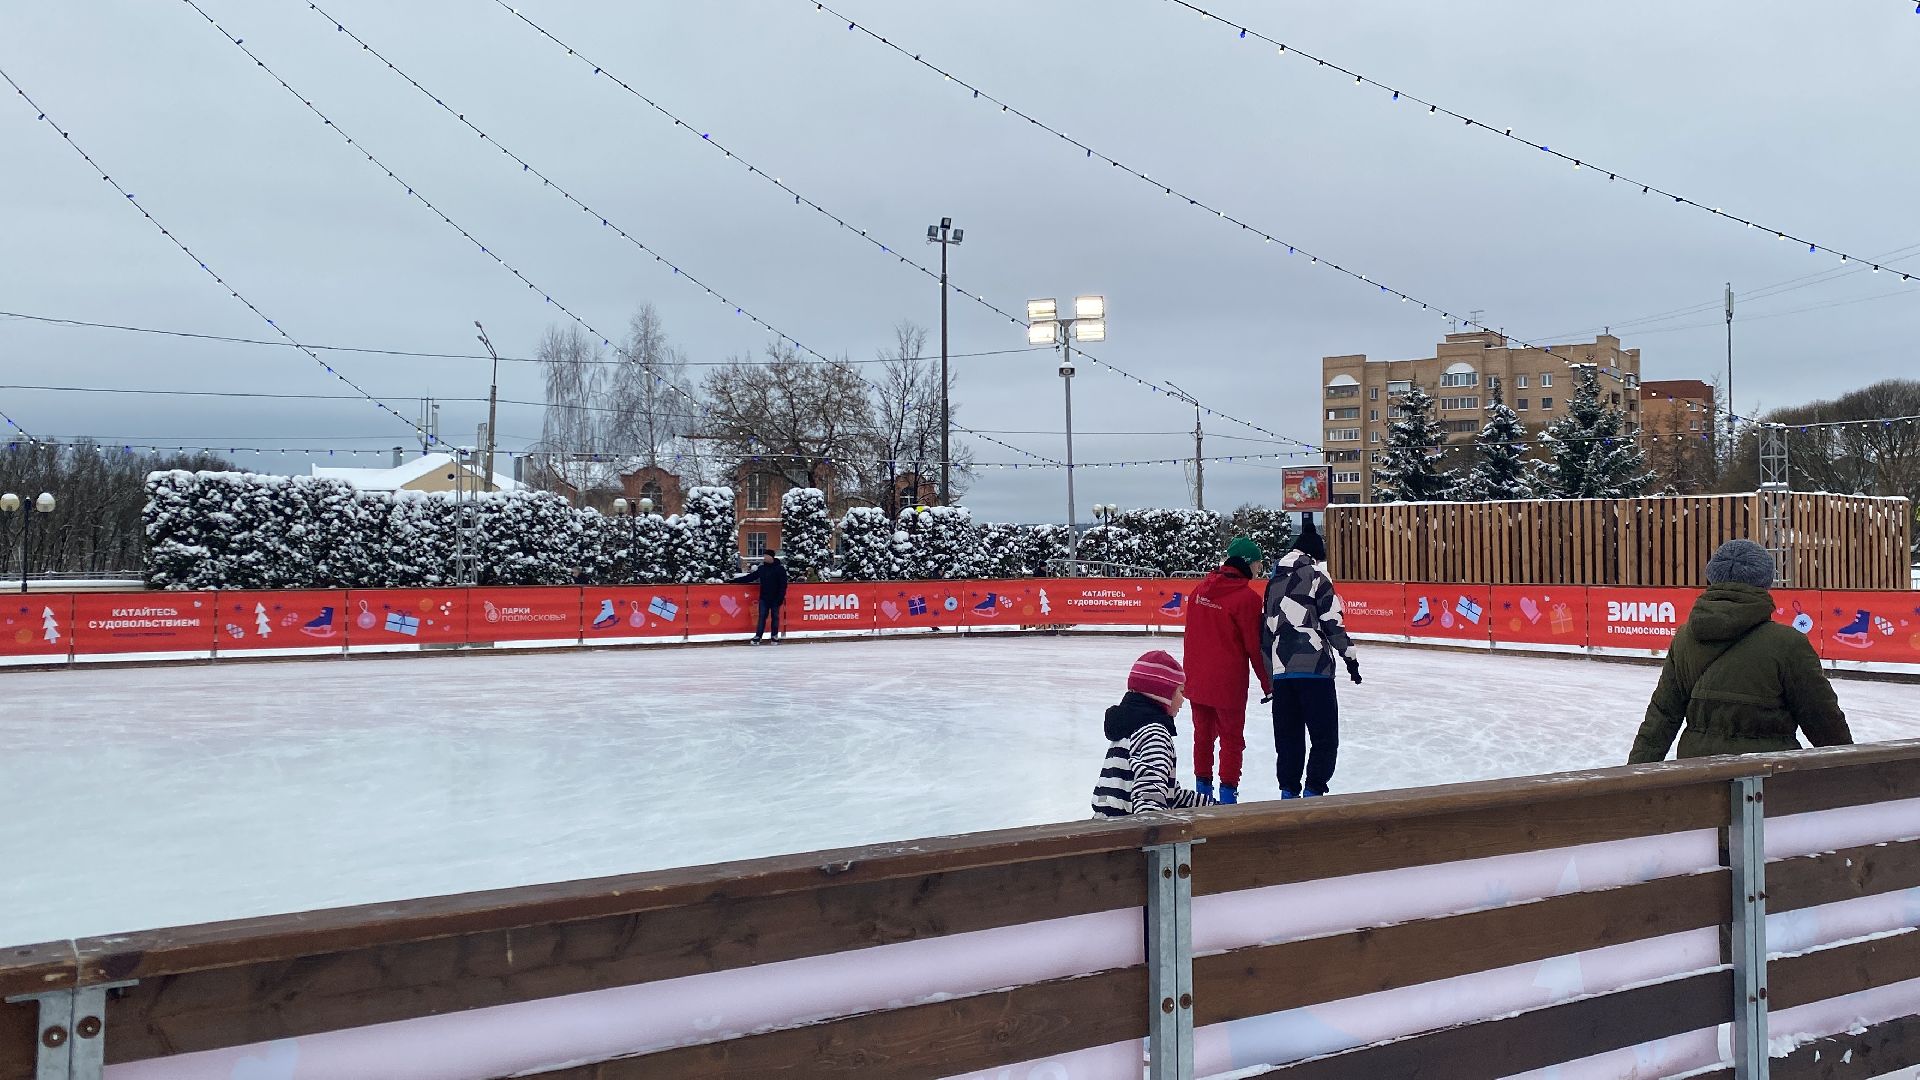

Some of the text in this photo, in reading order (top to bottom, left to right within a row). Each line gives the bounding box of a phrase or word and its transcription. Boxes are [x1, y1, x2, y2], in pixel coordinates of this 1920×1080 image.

[1082, 590, 1126, 598] КАТАЙТЕСЬ
[803, 594, 860, 611] ЗИМА
[1074, 599, 1142, 607] УДОВОЛЬСТВИЕМ!
[112, 607, 177, 616] КАТАЙТЕСЬ
[1348, 608, 1393, 616] ПОДМОСКОВЬЯ
[1607, 601, 1676, 623] ЗИМА
[809, 613, 859, 621] ПОДМОСКОВЬЕ
[89, 619, 200, 629] С УДОВОЛЬСТВИЕМ!
[1614, 626, 1677, 636] ПОДМОСКОВЬЕ
